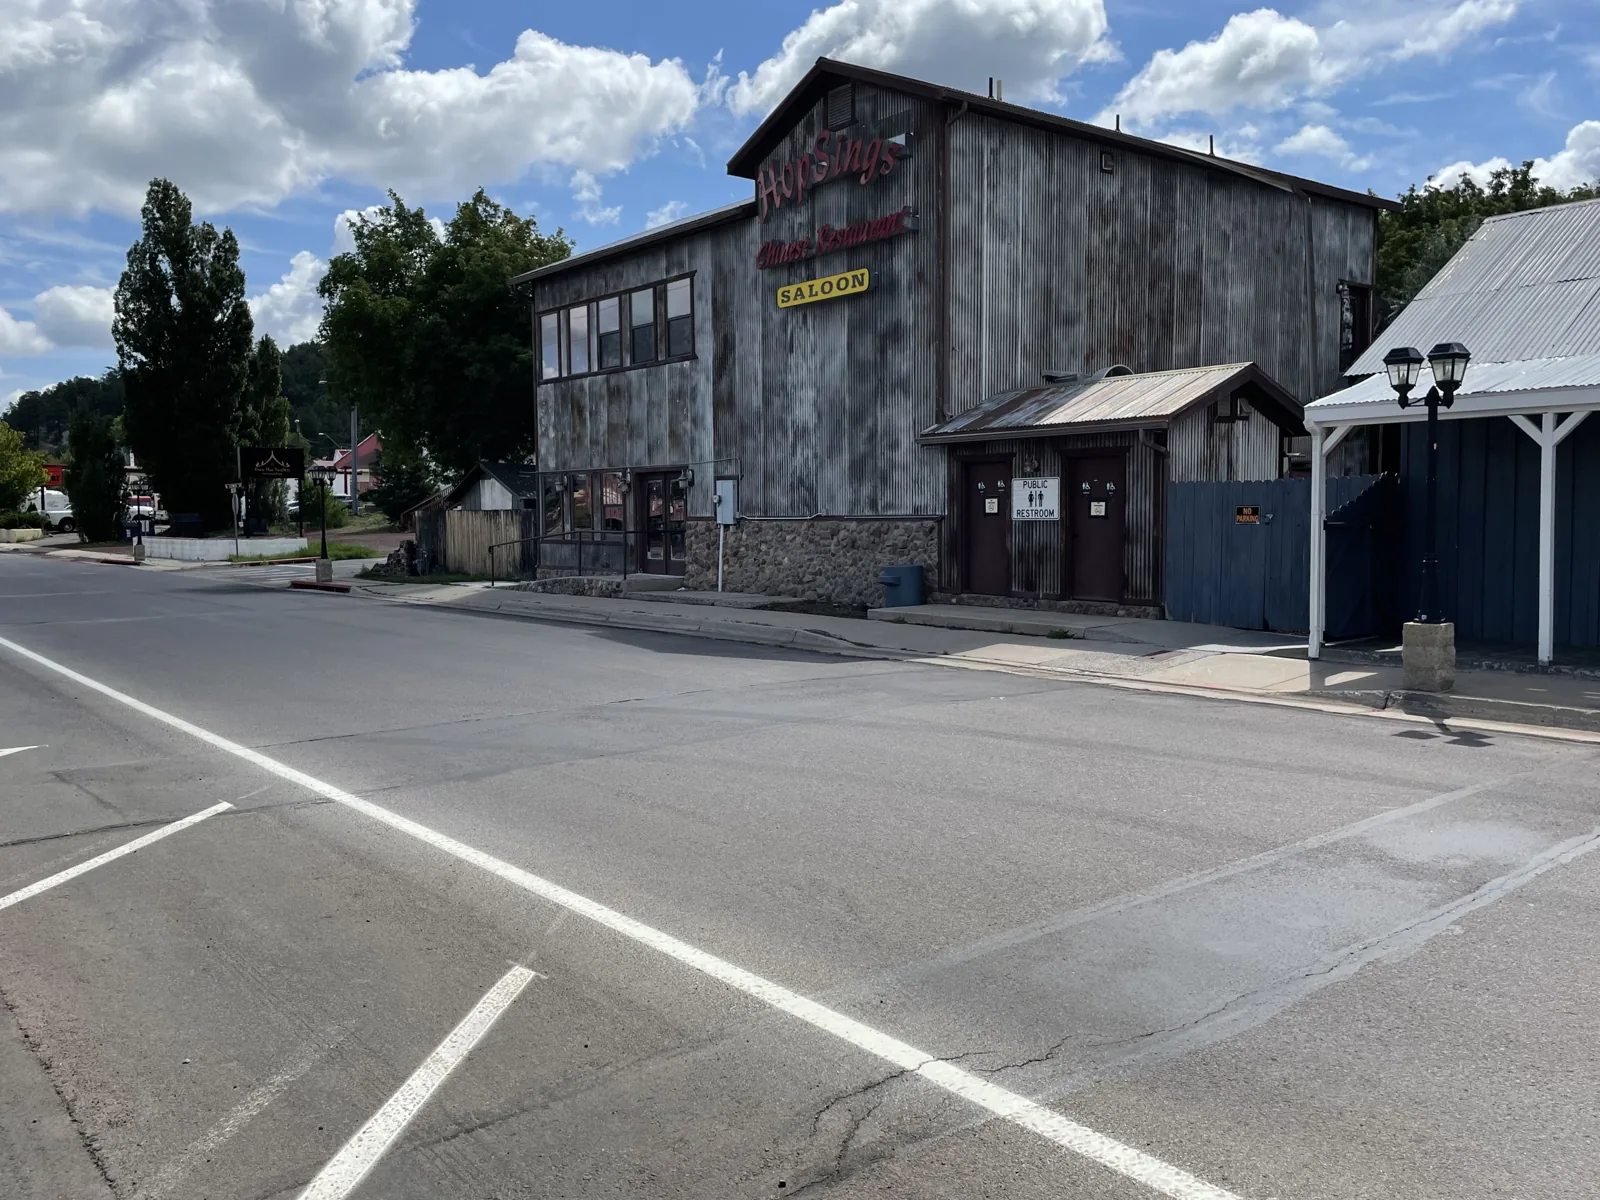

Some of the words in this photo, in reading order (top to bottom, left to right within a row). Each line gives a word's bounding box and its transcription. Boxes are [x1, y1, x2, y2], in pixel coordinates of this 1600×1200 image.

[756, 237, 811, 270] Chinese
[815, 206, 911, 253] Restaurant
[781, 272, 866, 304] SALOON
[1022, 480, 1048, 489] PUBLIC
[1016, 509, 1055, 518] RESTROOM
